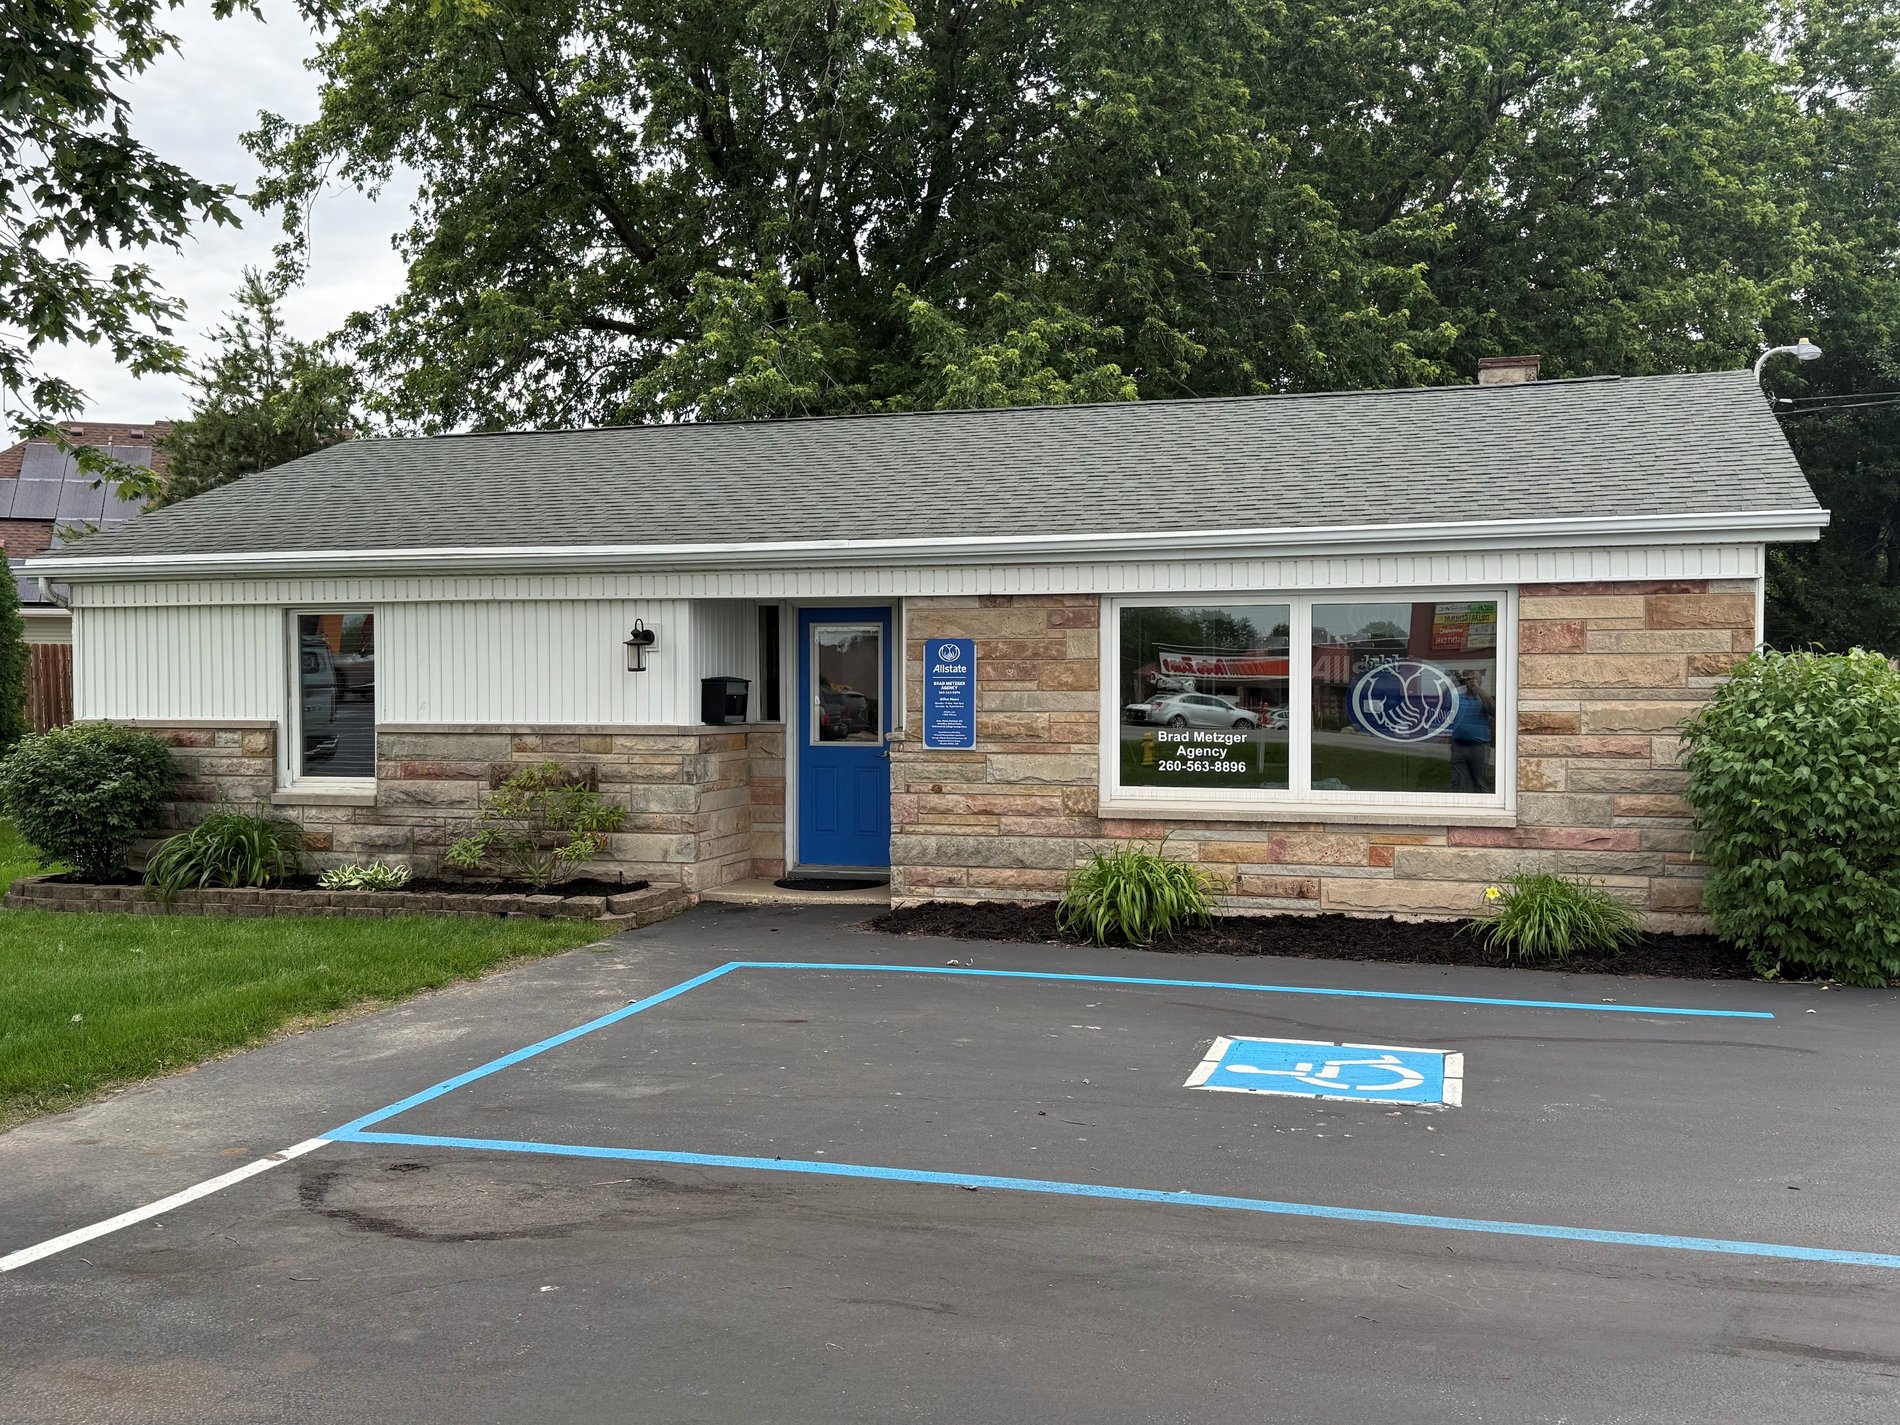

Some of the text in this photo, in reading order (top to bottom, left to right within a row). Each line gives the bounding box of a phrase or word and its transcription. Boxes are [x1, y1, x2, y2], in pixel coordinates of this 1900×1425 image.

[932, 664, 967, 673] Allstate
[1158, 731, 1247, 745] Brad Metzger
[1176, 745, 1227, 759] Agency
[1158, 760, 1247, 773] 260-563-8896
